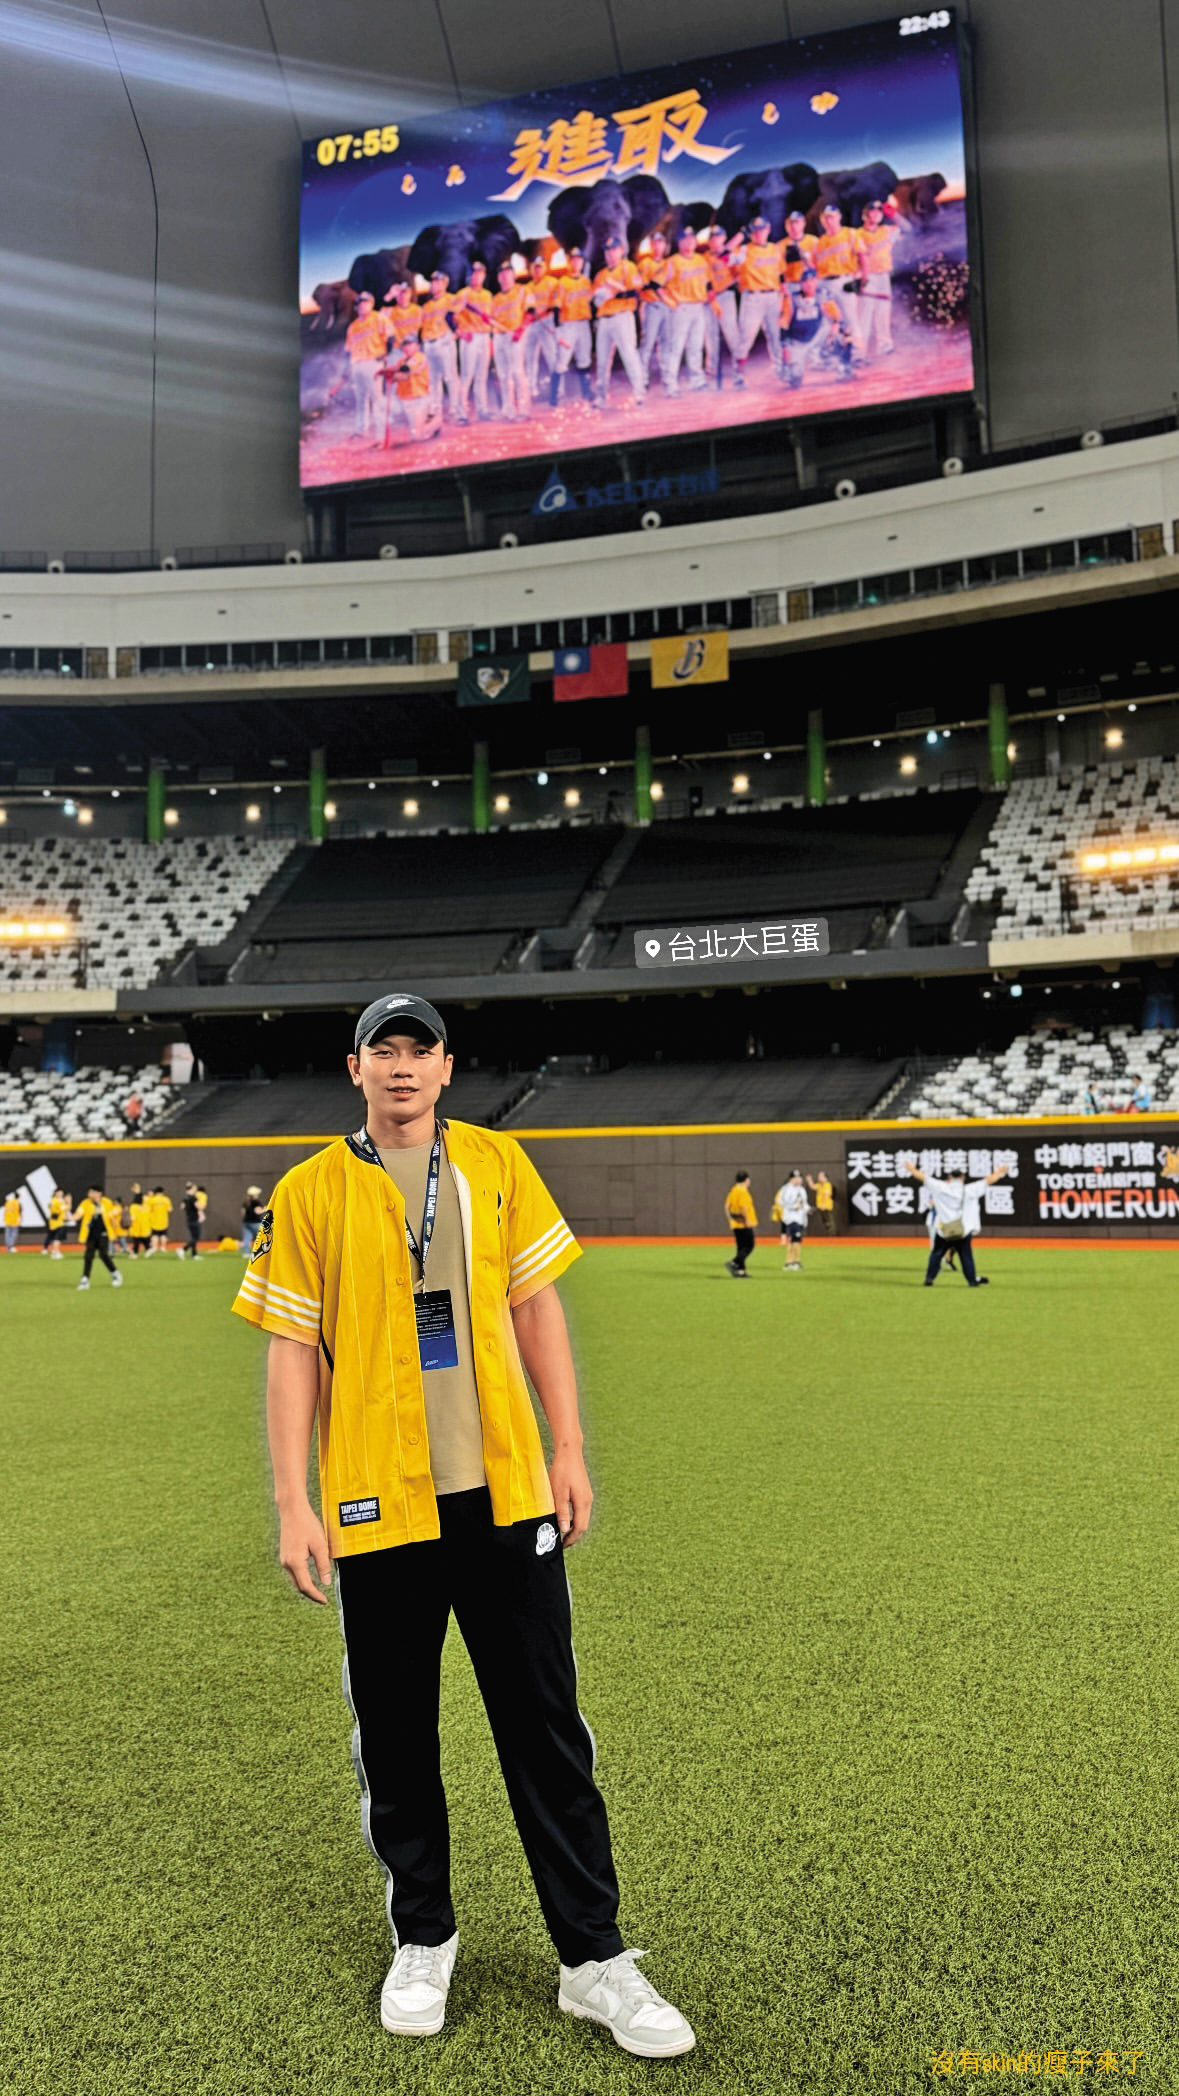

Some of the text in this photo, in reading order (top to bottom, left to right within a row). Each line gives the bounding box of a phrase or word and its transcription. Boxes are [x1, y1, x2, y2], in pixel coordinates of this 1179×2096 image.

[317, 125, 400, 166] 07:55
[486, 89, 743, 201] 進取
[1034, 1141, 1155, 1169] 中華鋁門窗
[429, 1177, 438, 1196] DOME
[885, 1185, 1015, 1215] 安區
[427, 1197, 435, 1218] TAIPEI
[1039, 1188, 1179, 1219] HOMERUN
[341, 1500, 378, 1515] TAIPEI DOME
